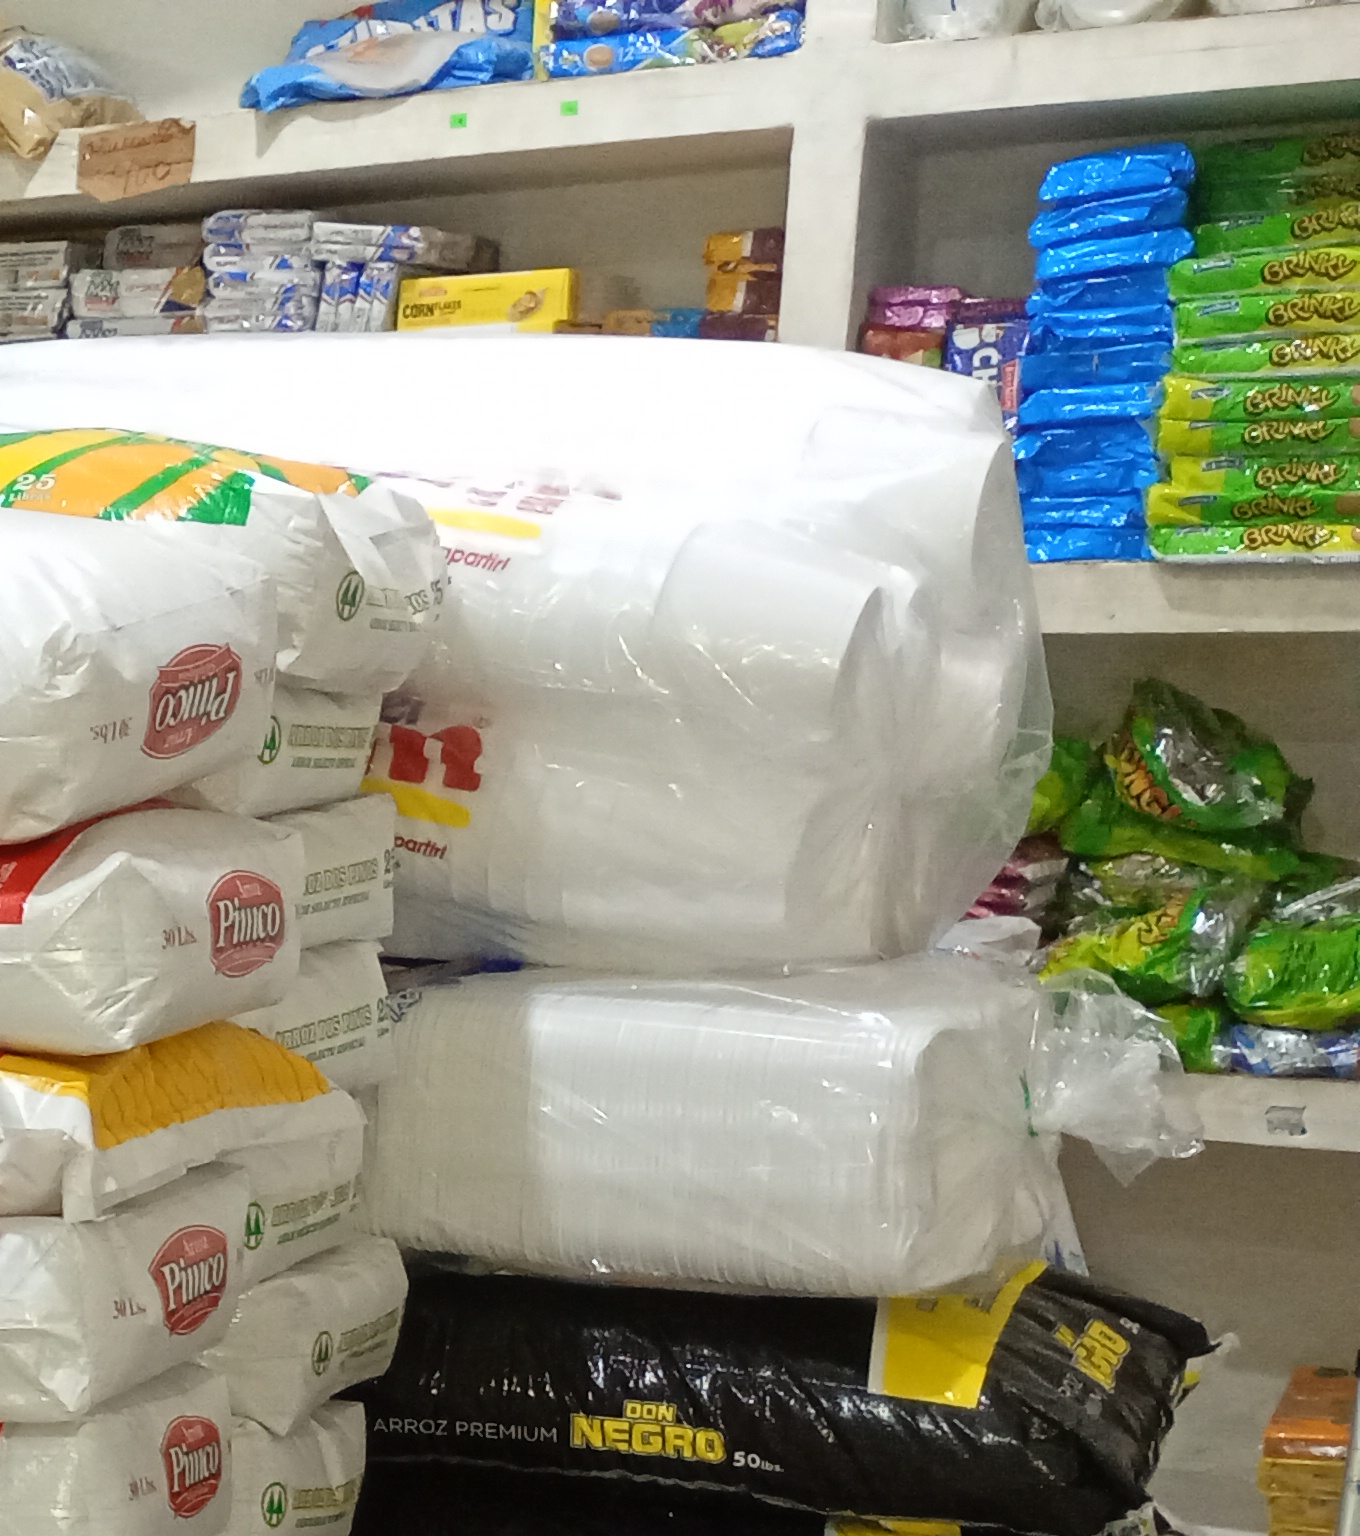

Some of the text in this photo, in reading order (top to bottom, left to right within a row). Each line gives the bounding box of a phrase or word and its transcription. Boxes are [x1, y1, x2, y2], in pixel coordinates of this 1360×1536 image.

[1263, 251, 1356, 284] BRINKY
[402, 302, 436, 321] CORN
[1244, 383, 1340, 414] BRINKY
[15, 472, 57, 490] 25
[1255, 458, 1348, 489] BRINKY
[444, 545, 509, 573] partir!
[216, 899, 280, 950] Pimco
[161, 1253, 226, 1311] Pimco
[624, 1400, 677, 1424] DON
[374, 1418, 448, 1436] ARROZ
[455, 1421, 558, 1444] PREMIUM
[570, 1413, 727, 1463] NEGRO
